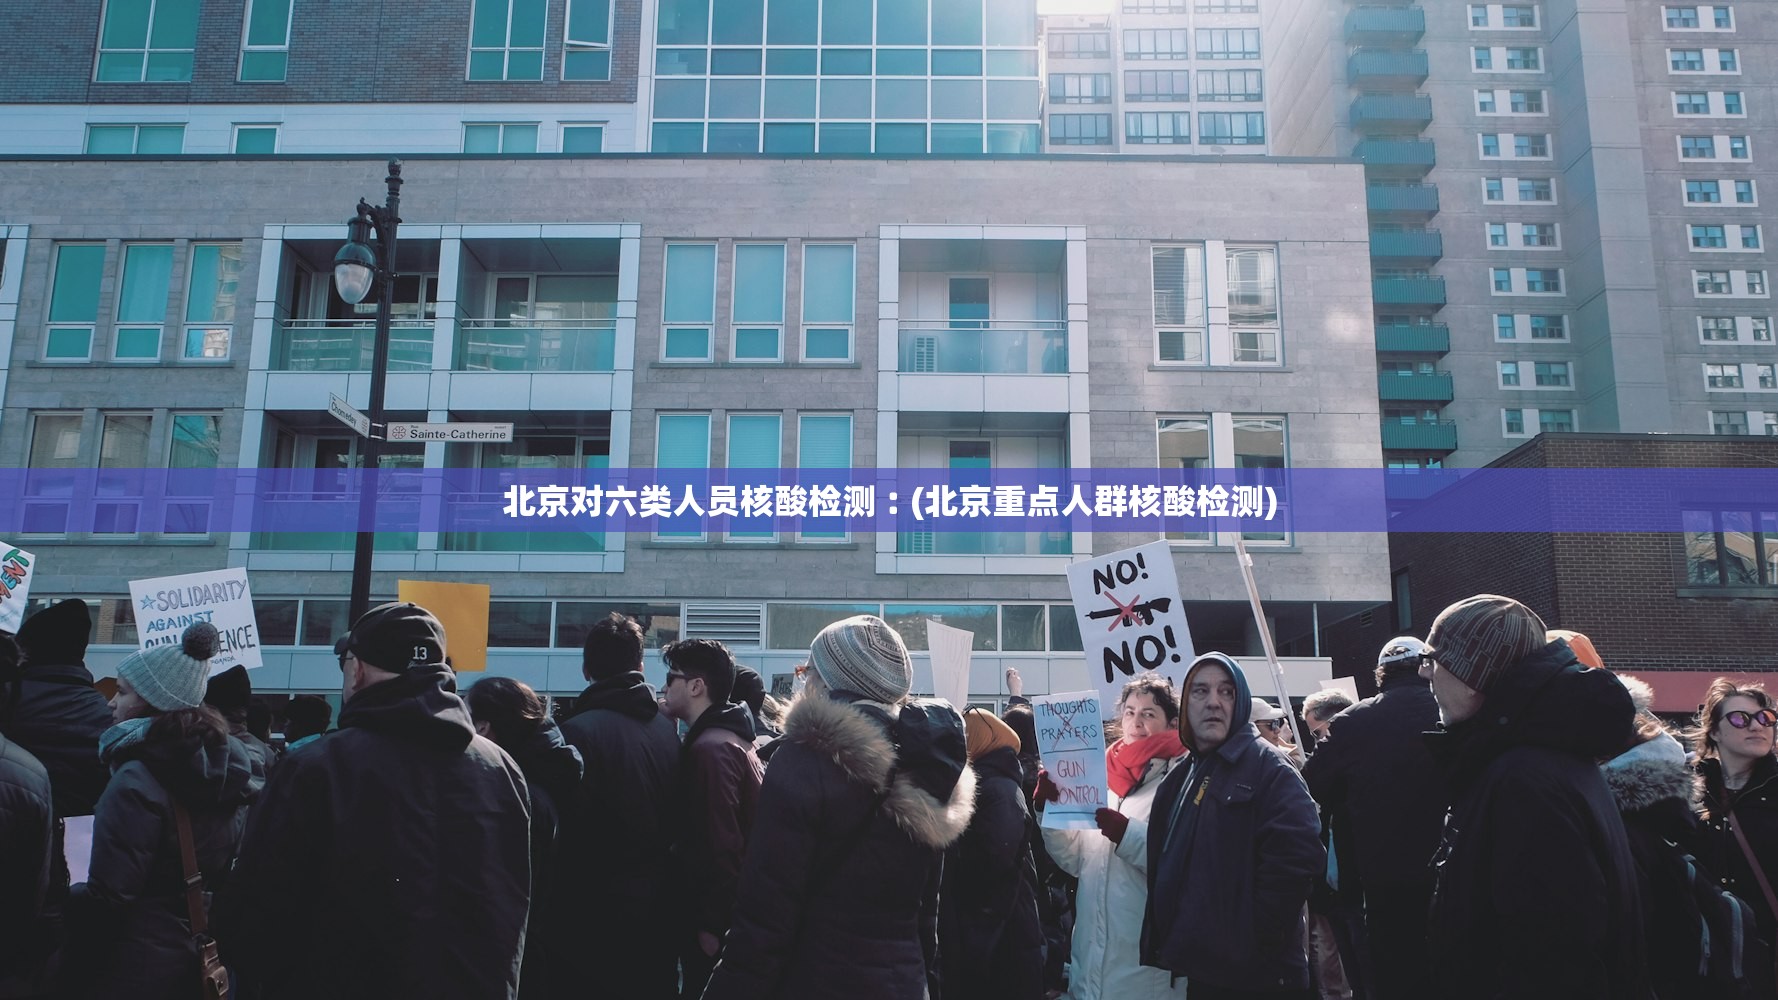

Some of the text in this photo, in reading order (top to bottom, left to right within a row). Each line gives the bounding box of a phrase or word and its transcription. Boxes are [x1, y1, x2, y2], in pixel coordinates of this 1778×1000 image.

[410, 429, 506, 439] Sainte-Catherine
[1093, 552, 1149, 595] NO!
[156, 579, 247, 611] SOLIDARITY
[146, 610, 214, 633] AGAINST
[413, 646, 428, 660] 13
[1103, 625, 1181, 683] NO!
[1040, 699, 1097, 716] THOUGHTS
[1041, 724, 1098, 741] PRAYERS
[1057, 757, 1086, 778] GUN
[1050, 785, 1104, 805] ONTROL
